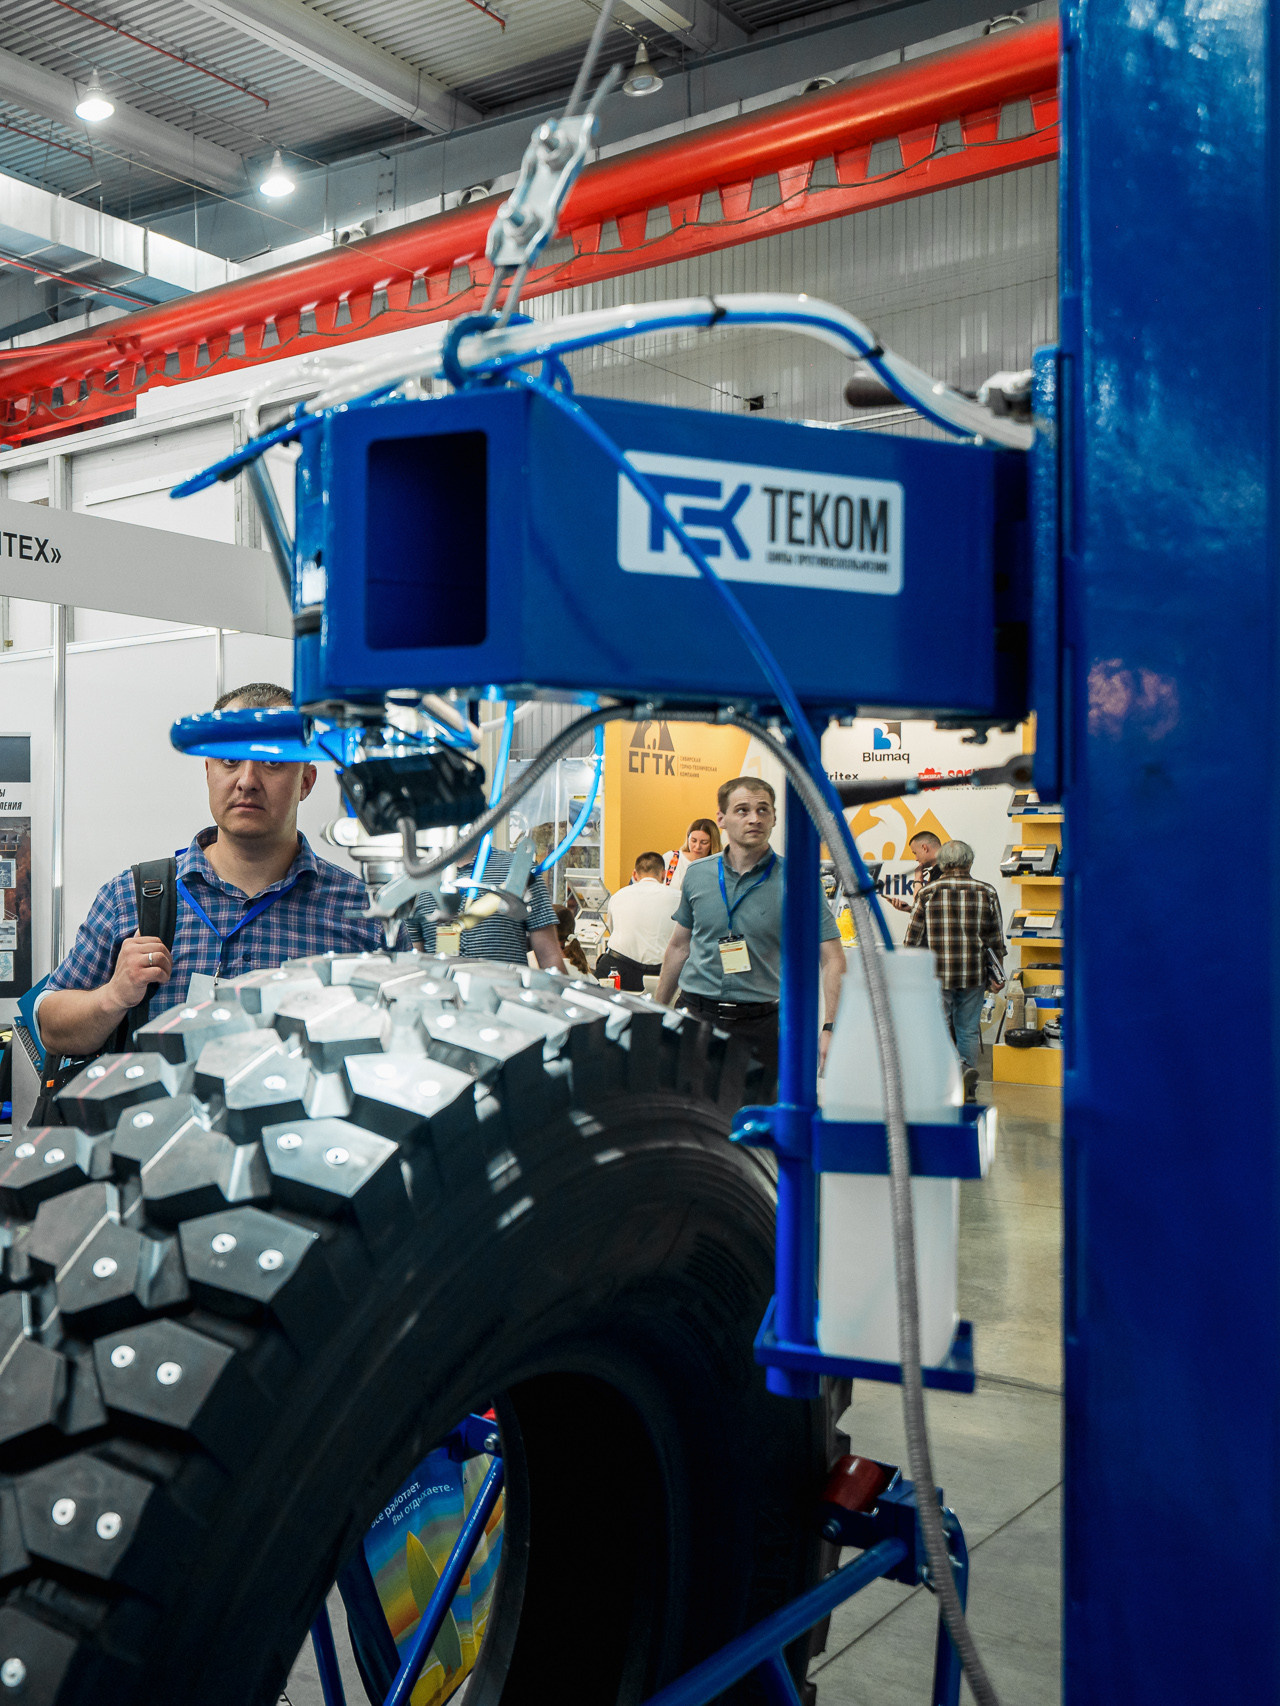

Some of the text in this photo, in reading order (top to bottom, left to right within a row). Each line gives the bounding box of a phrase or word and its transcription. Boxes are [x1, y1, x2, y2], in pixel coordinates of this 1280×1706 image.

[762, 486, 889, 555] ТЕКОМ
[628, 750, 676, 776] СГТК
[862, 752, 910, 764] Blumaq
